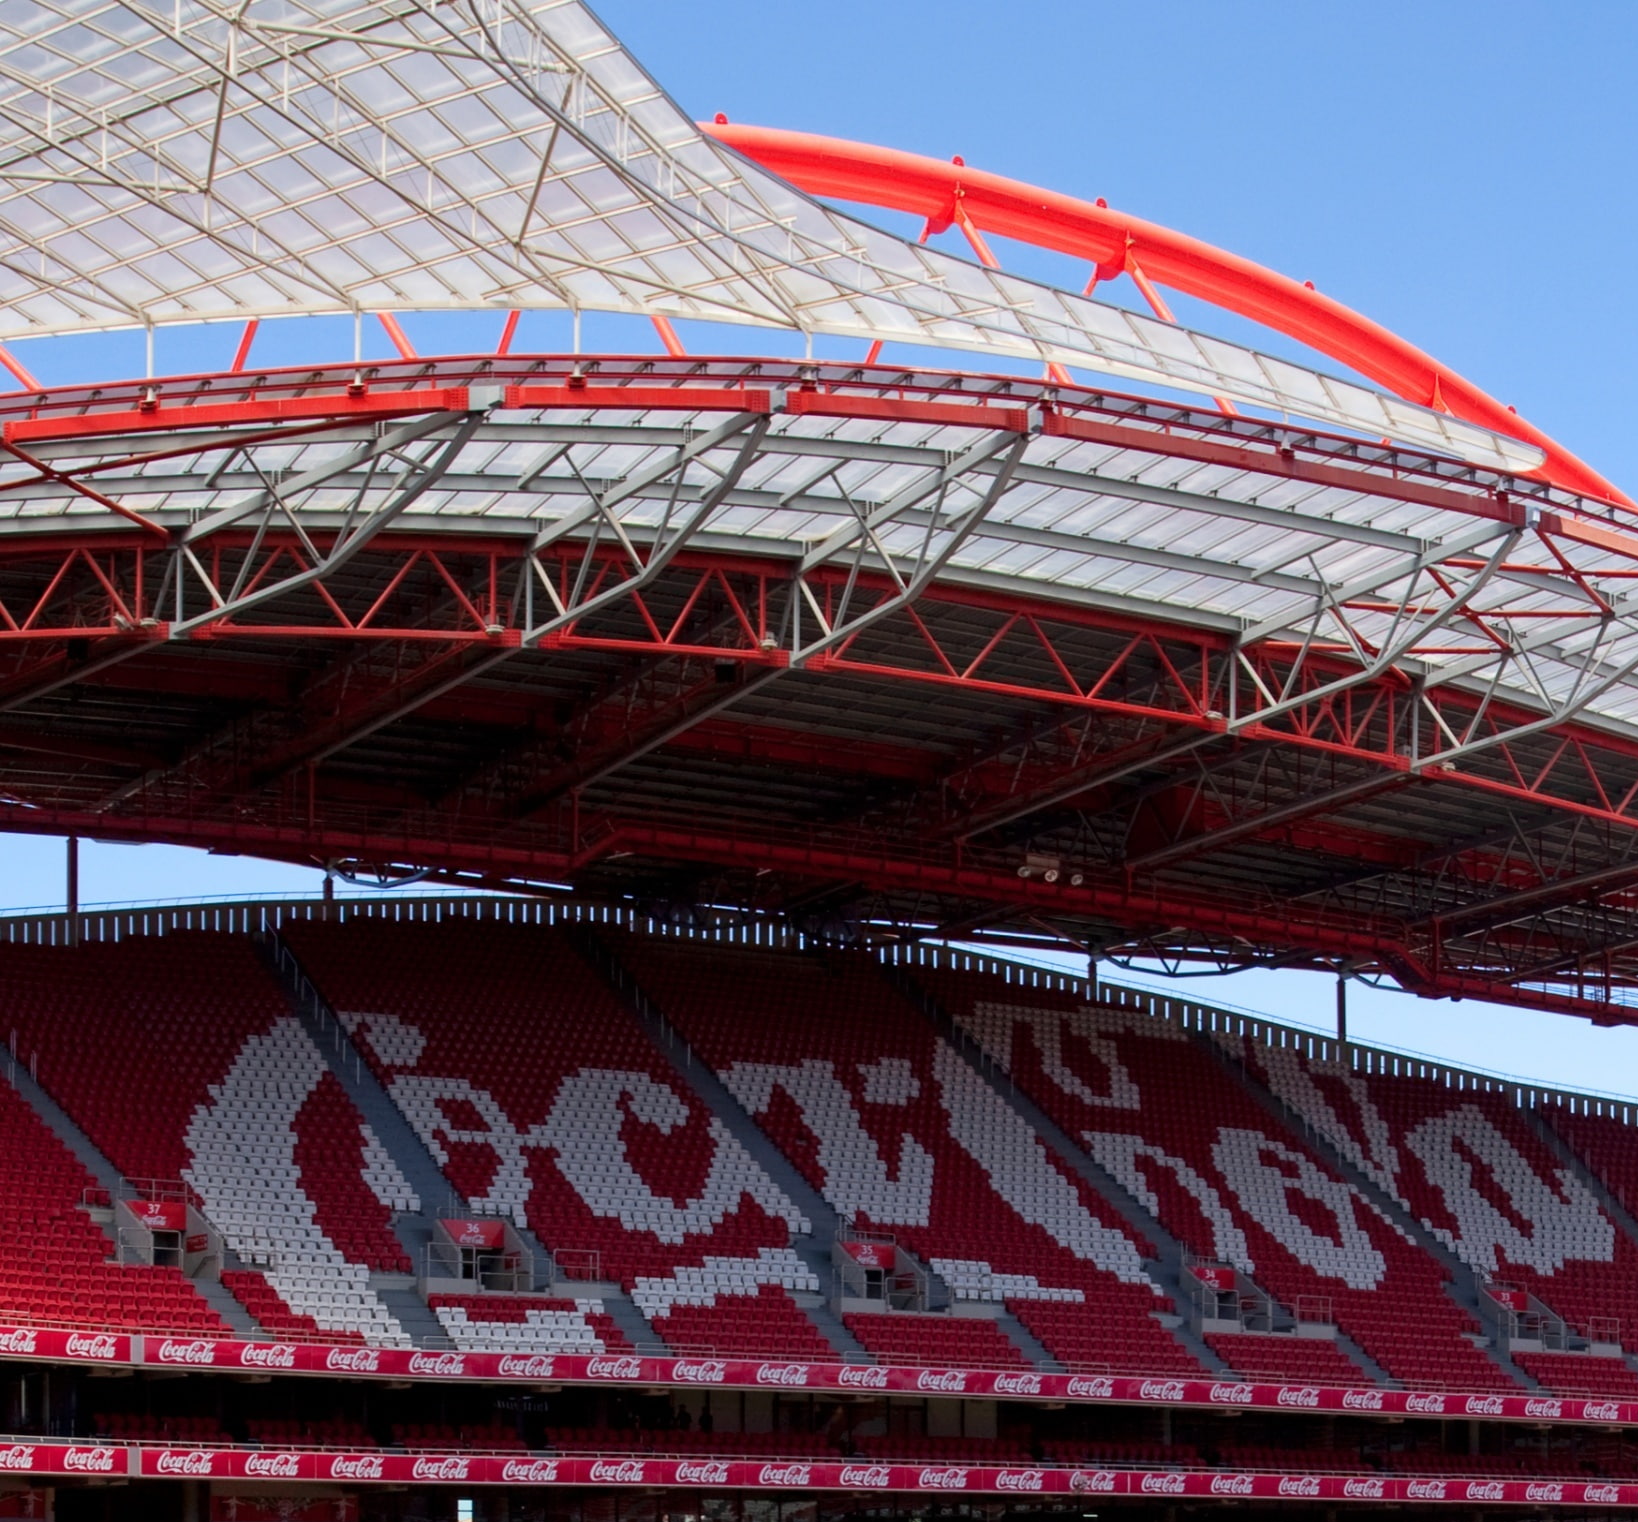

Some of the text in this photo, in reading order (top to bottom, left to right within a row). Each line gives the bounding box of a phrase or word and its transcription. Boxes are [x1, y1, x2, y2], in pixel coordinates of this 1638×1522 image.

[148, 1204, 161, 1215] 37
[466, 1223, 480, 1234] 36
[159, 1340, 215, 1363] Coca-Cola
[1068, 1377, 1113, 1396] Coca-Cola
[590, 1461, 644, 1481] Coca-Cola
